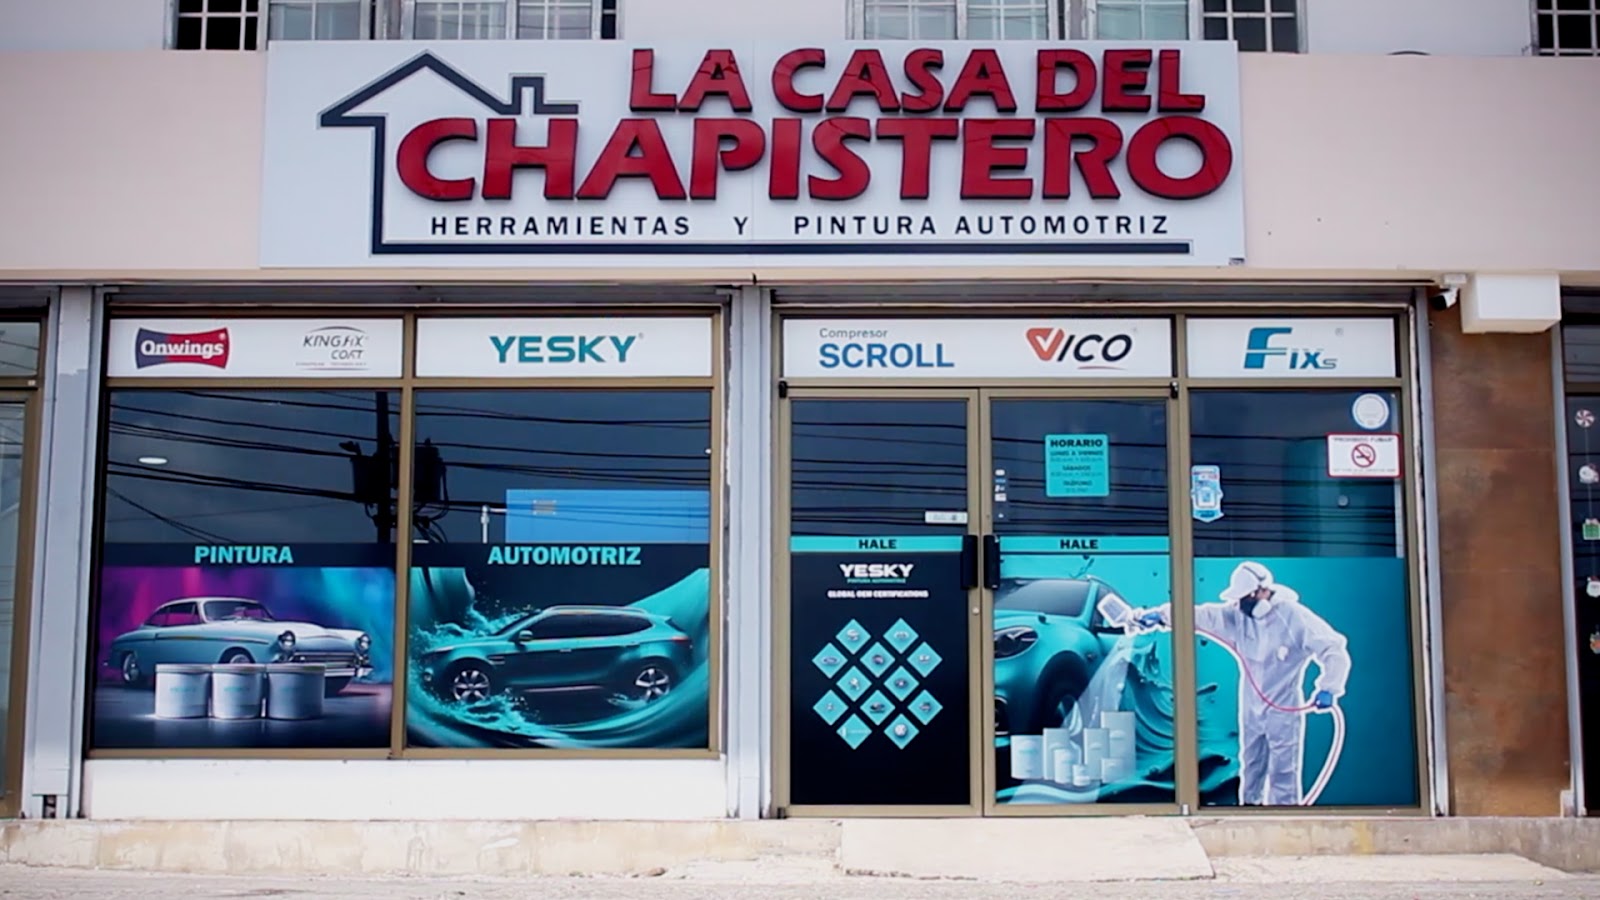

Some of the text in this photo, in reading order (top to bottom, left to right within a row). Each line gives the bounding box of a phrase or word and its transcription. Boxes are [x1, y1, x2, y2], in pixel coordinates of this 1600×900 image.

[629, 48, 1206, 112] LA CASA DEL
[396, 115, 1234, 200] CHAPISTERO
[431, 215, 1169, 236] HERRAMIENTAS Y PINTURA AUTOMOTRIZ
[819, 327, 888, 340] Compresor
[140, 340, 224, 359] Onwings
[489, 335, 637, 363] YESKY
[1025, 327, 1133, 363] VICO
[818, 343, 955, 368] SCROLL
[1050, 439, 1103, 447] HORARIO
[858, 539, 897, 550] HALE
[1060, 539, 1099, 550] HALE
[193, 546, 294, 565] PINTURA
[487, 545, 642, 566] AUTOMOTRIZ
[839, 563, 914, 578] YESKY
